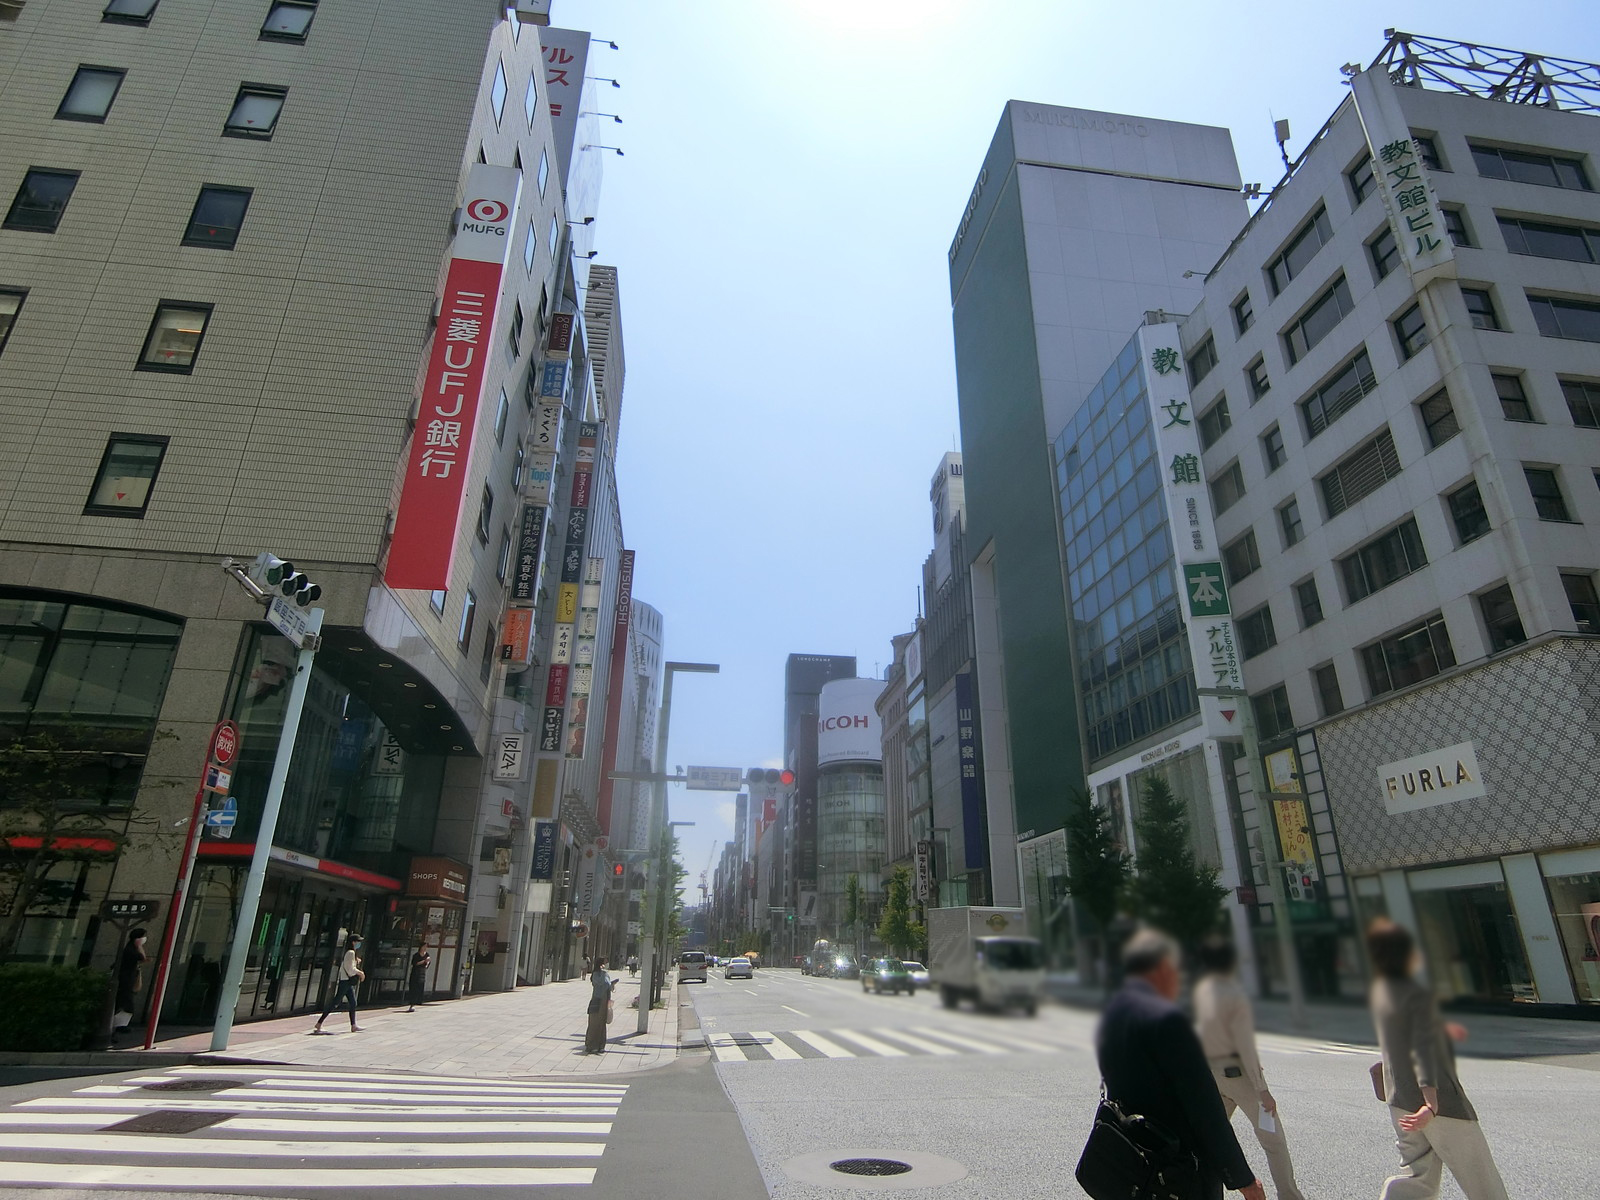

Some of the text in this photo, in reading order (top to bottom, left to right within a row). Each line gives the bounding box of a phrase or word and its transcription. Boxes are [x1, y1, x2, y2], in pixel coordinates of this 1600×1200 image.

[1022, 109, 1150, 138] MIKIMOTO
[1379, 139, 1441, 256] 教文館ビル
[462, 222, 505, 236] MUFG
[420, 291, 485, 479] 三菱UFJ銀行
[1151, 347, 1201, 485] 教文館
[531, 467, 551, 483] Top's
[1185, 497, 1200, 527] SINCE
[618, 554, 633, 625] MITSUKOSHI
[1189, 571, 1223, 607] 本
[501, 737, 521, 770] IBIZA
[959, 708, 975, 778] 山野楽器
[1385, 759, 1473, 800] FURLA
[412, 872, 438, 880] SHOPS
